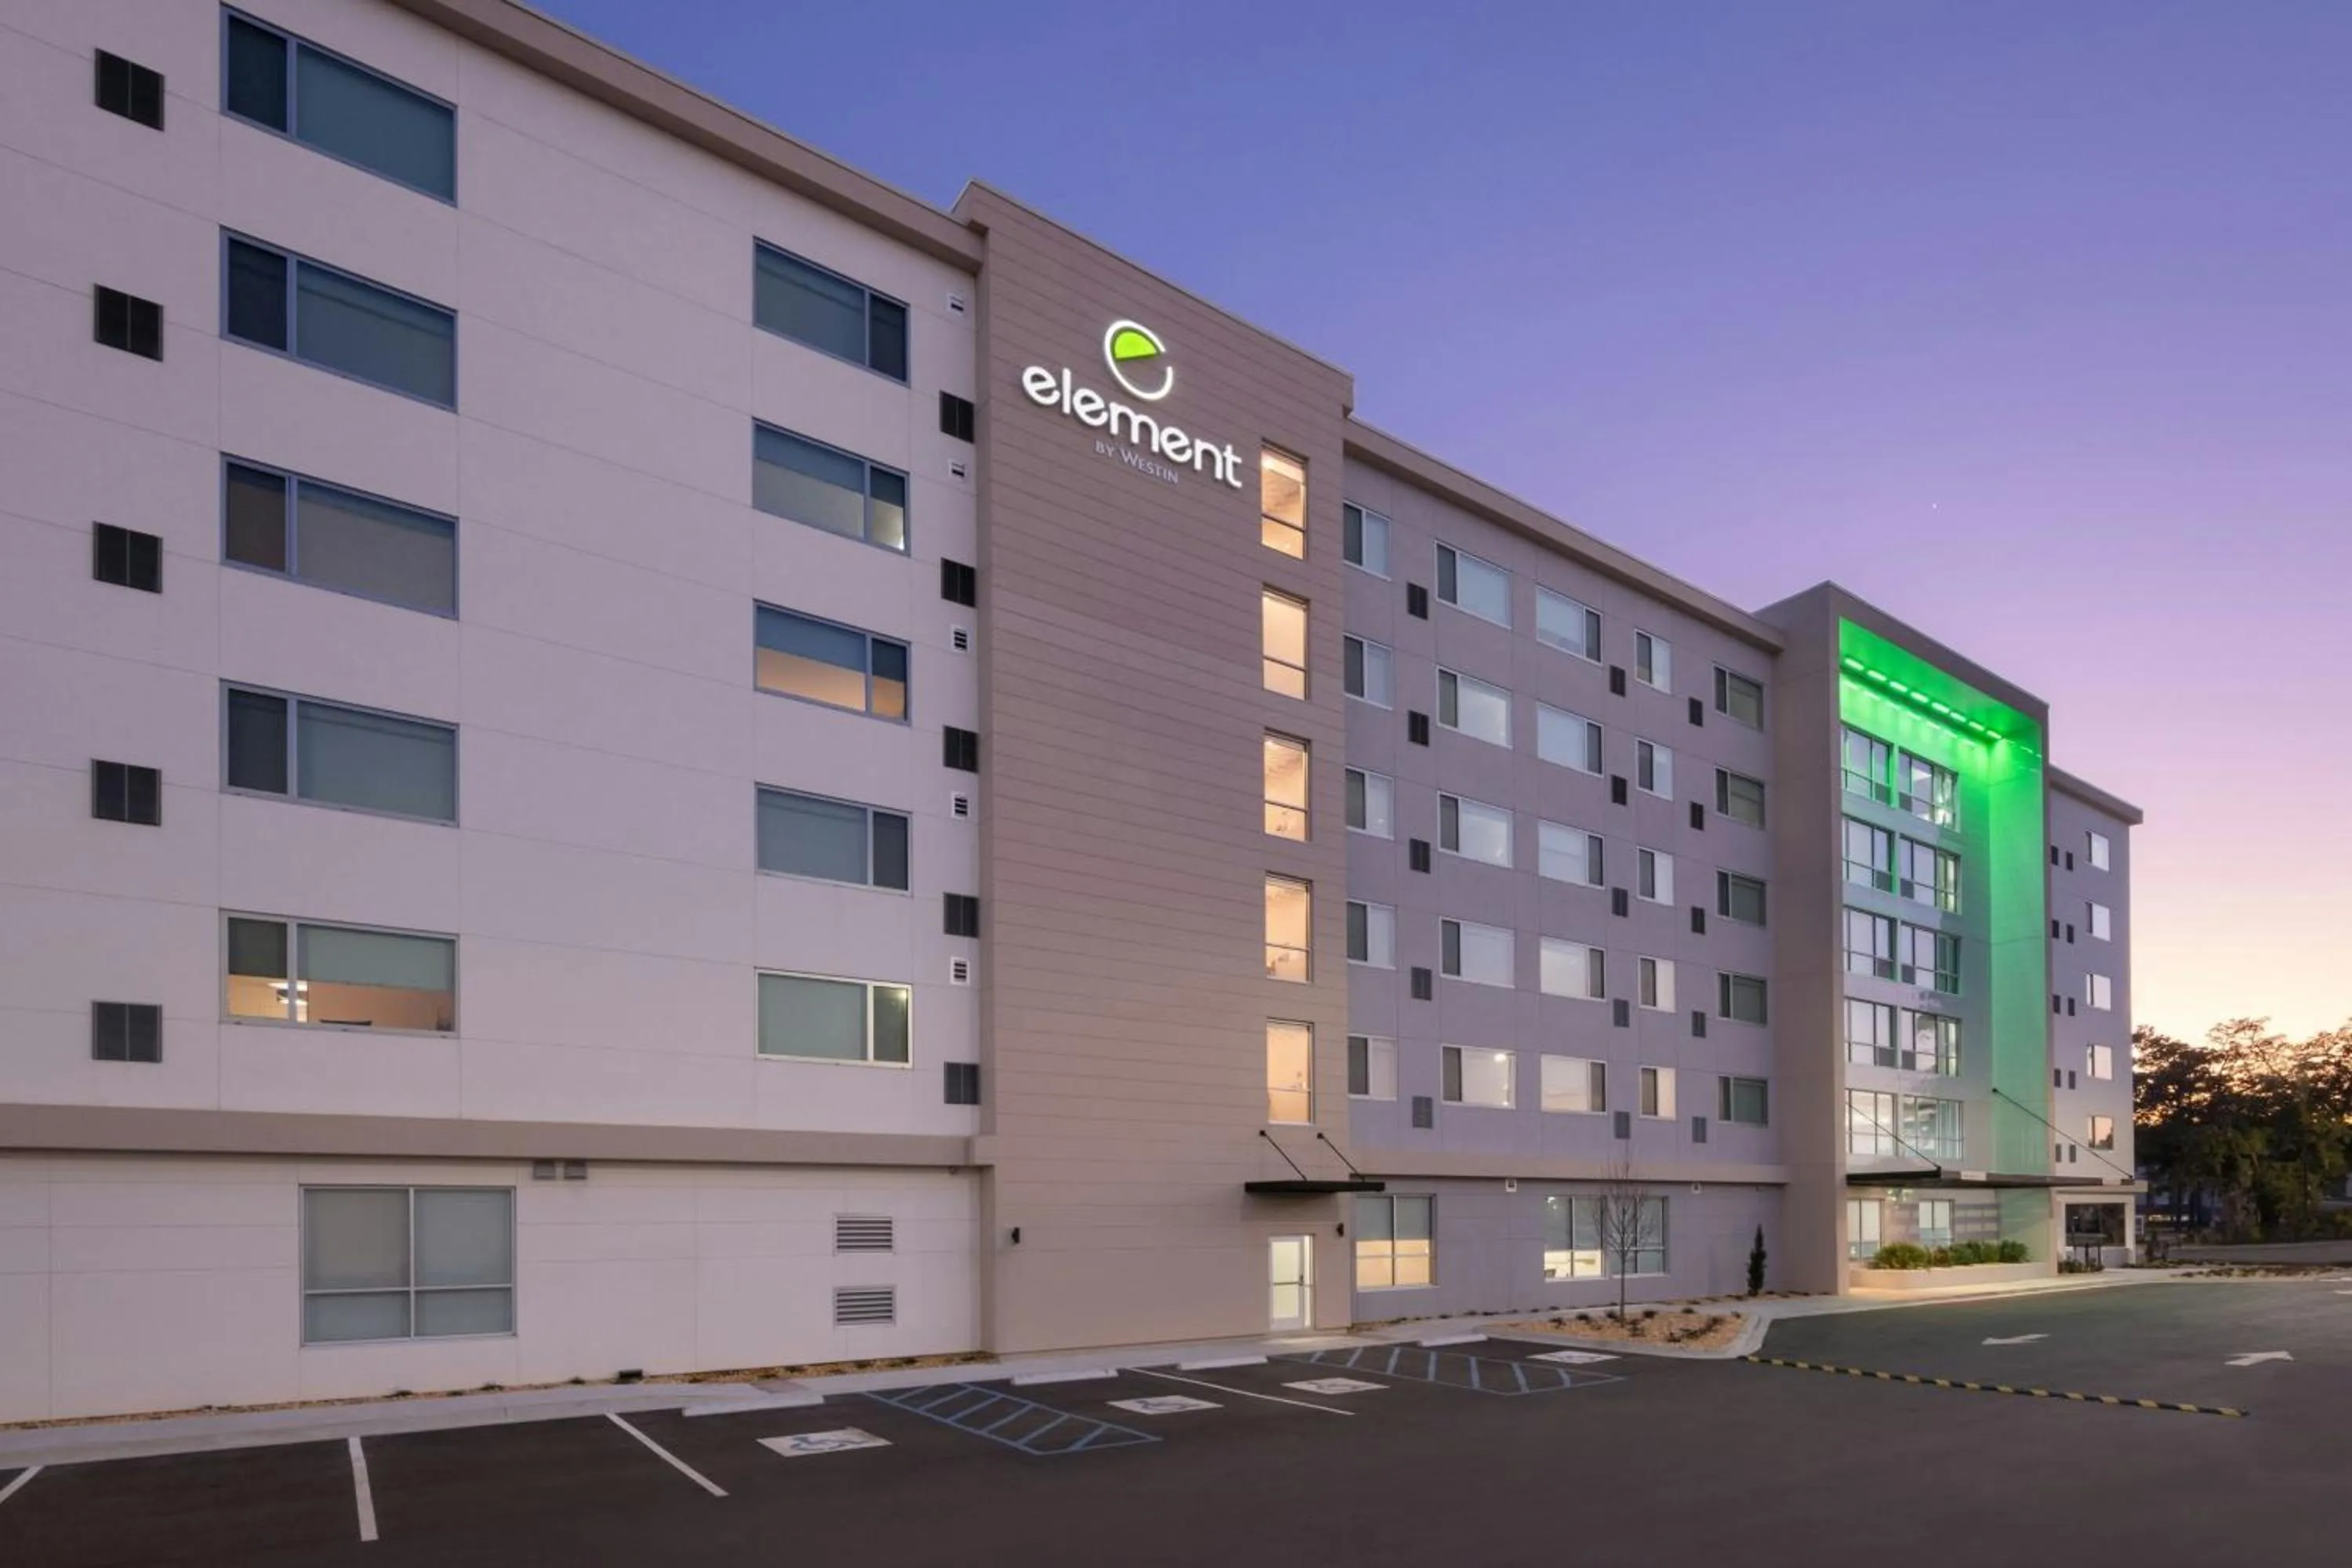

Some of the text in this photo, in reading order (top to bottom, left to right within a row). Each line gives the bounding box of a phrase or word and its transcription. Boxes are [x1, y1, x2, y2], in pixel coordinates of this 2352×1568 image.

[1022, 365, 1242, 488] element
[1095, 440, 1178, 484] BY WESTIN
